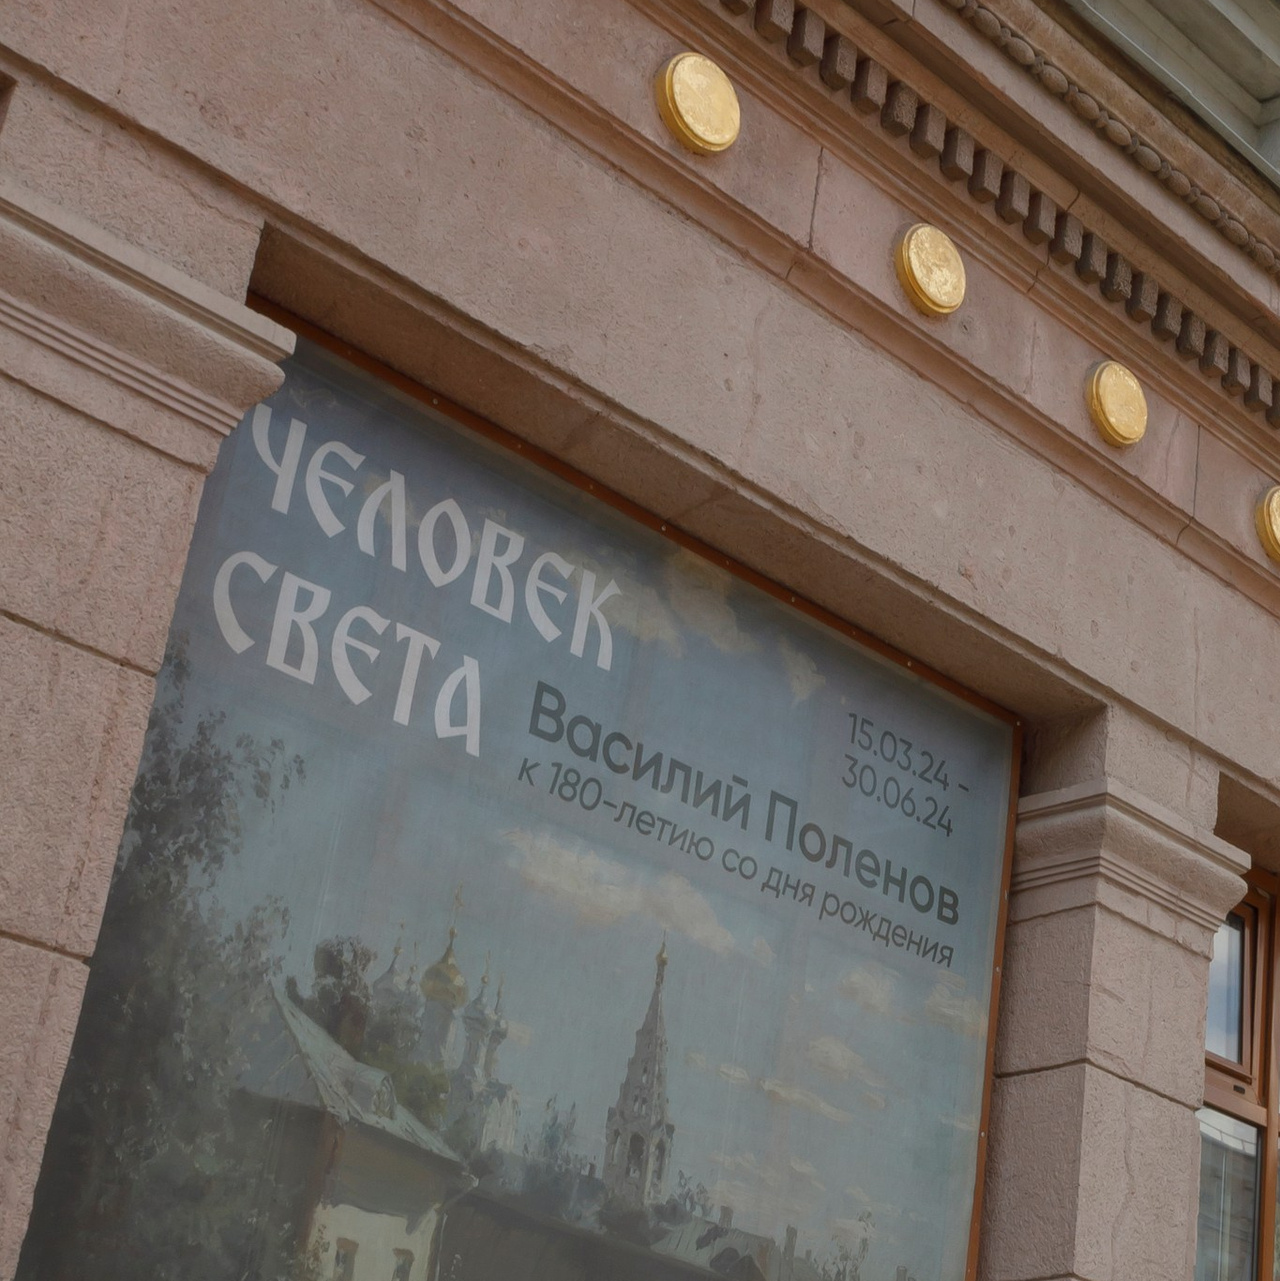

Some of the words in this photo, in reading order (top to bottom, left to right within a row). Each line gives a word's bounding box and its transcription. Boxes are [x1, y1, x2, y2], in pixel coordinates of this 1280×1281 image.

[252, 403, 622, 671] ЧЕЛОВЕК
[213, 551, 481, 757] СВЕТА
[848, 713, 950, 791] 15.03.24
[517, 758, 541, 786] к
[549, 762, 714, 862] 180-летию
[722, 848, 758, 880] со
[761, 868, 816, 907] дня
[819, 890, 954, 968] рождения
[528, 680, 752, 831] Василий
[765, 790, 960, 925] Поленов
[842, 754, 954, 837] 30.06.24
